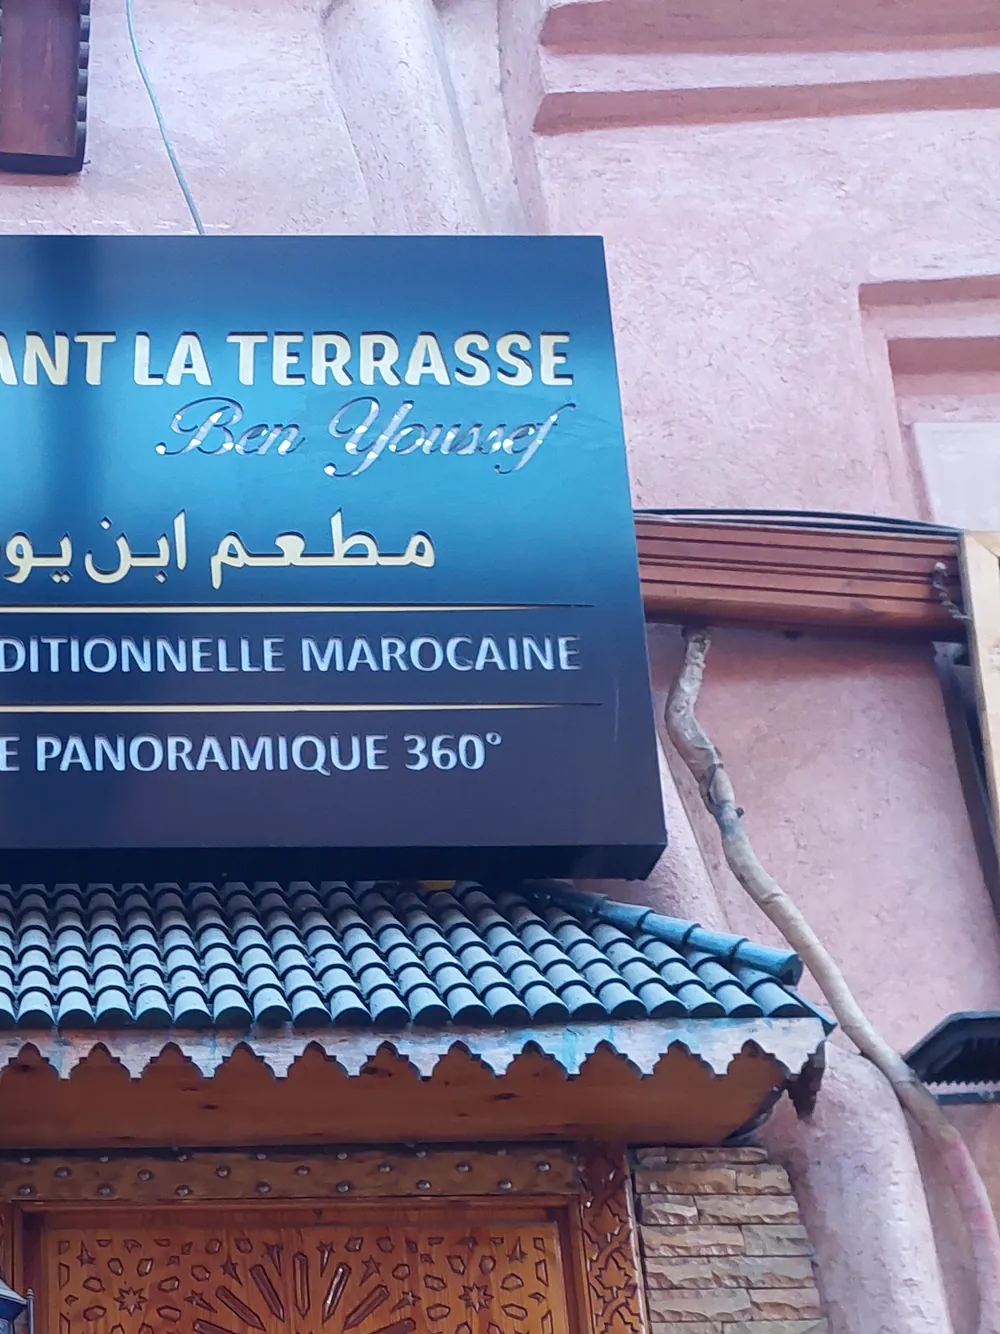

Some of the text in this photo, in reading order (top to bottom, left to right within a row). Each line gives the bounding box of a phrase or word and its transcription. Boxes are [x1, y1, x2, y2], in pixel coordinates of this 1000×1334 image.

[132, 331, 213, 386] LA
[226, 331, 574, 386] TERRASSE
[155, 396, 576, 477] Ben Youssef
[84, 508, 187, 583] ابن
[210, 507, 436, 590] مطعم
[302, 635, 582, 672] MAROCAINE
[37, 733, 390, 776] PANORAMIQUE
